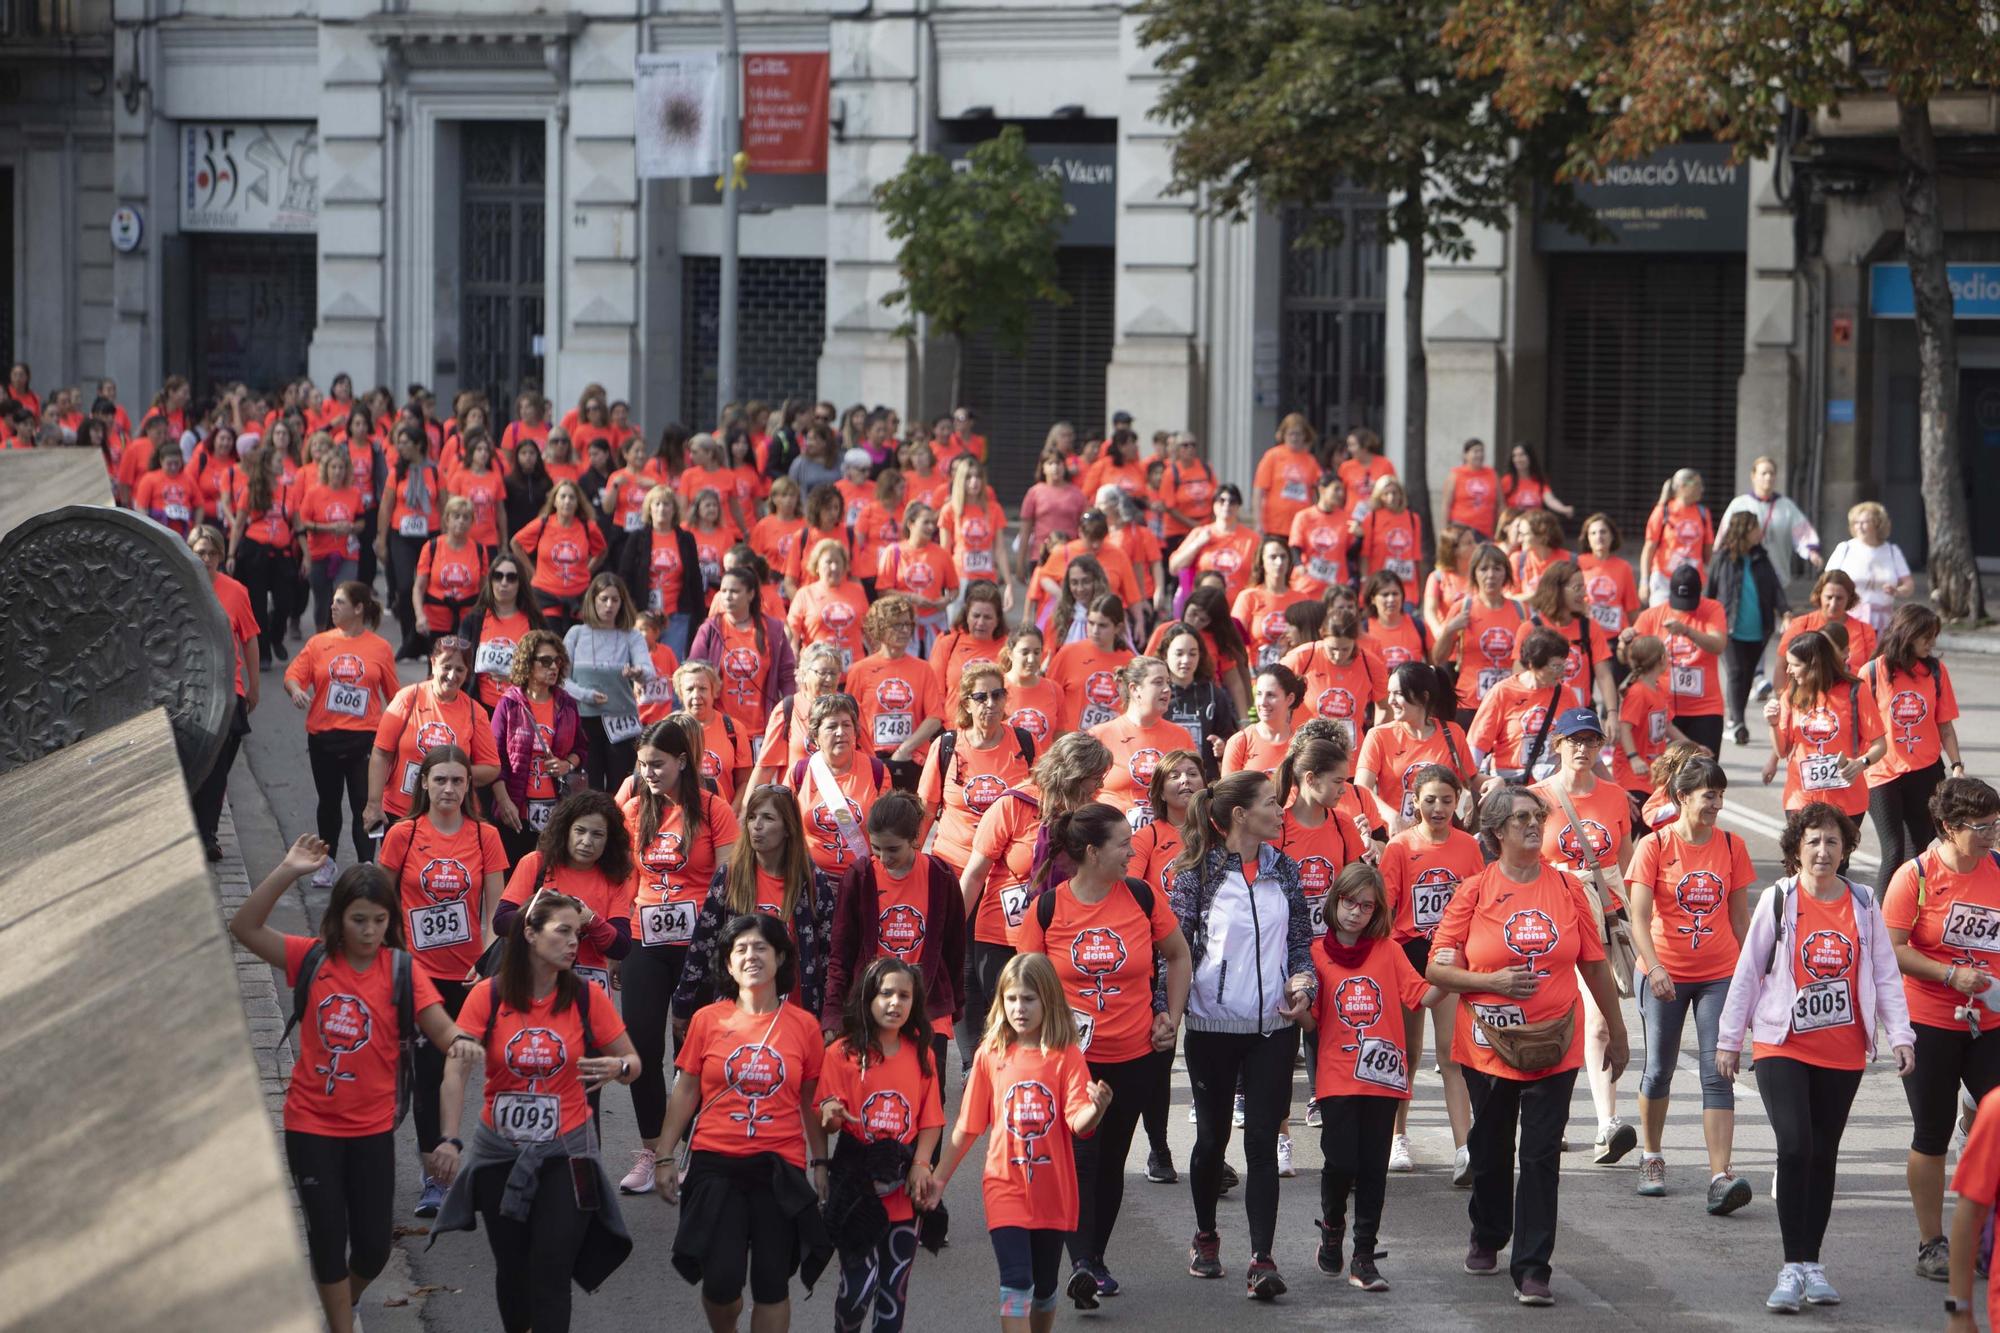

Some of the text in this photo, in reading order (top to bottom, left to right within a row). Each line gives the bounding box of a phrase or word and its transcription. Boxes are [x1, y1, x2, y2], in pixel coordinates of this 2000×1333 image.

[1596, 158, 1679, 186] NDACIÓ
[1950, 272, 2000, 301] edio
[335, 691, 361, 709] 606
[609, 716, 637, 734] 1415
[879, 721, 911, 737] 2483
[1811, 763, 1838, 783] 592
[648, 853, 676, 862] dona
[431, 879, 460, 889] dona
[1686, 893, 1715, 902] dona
[423, 912, 459, 937] 395
[652, 911, 688, 933] 394
[1950, 914, 2000, 941] 2854
[885, 928, 915, 939] dona
[1515, 932, 1547, 941] dona
[1082, 951, 1114, 961] dona
[1816, 947, 1841, 956] cursa
[1812, 954, 1843, 966] dona
[1345, 1001, 1375, 1011] dona
[1796, 990, 1846, 1019] 3005
[519, 1055, 553, 1065] dona
[500, 1105, 555, 1131] 1095
[1013, 1109, 1045, 1121] dona
[870, 1118, 901, 1130] dona
